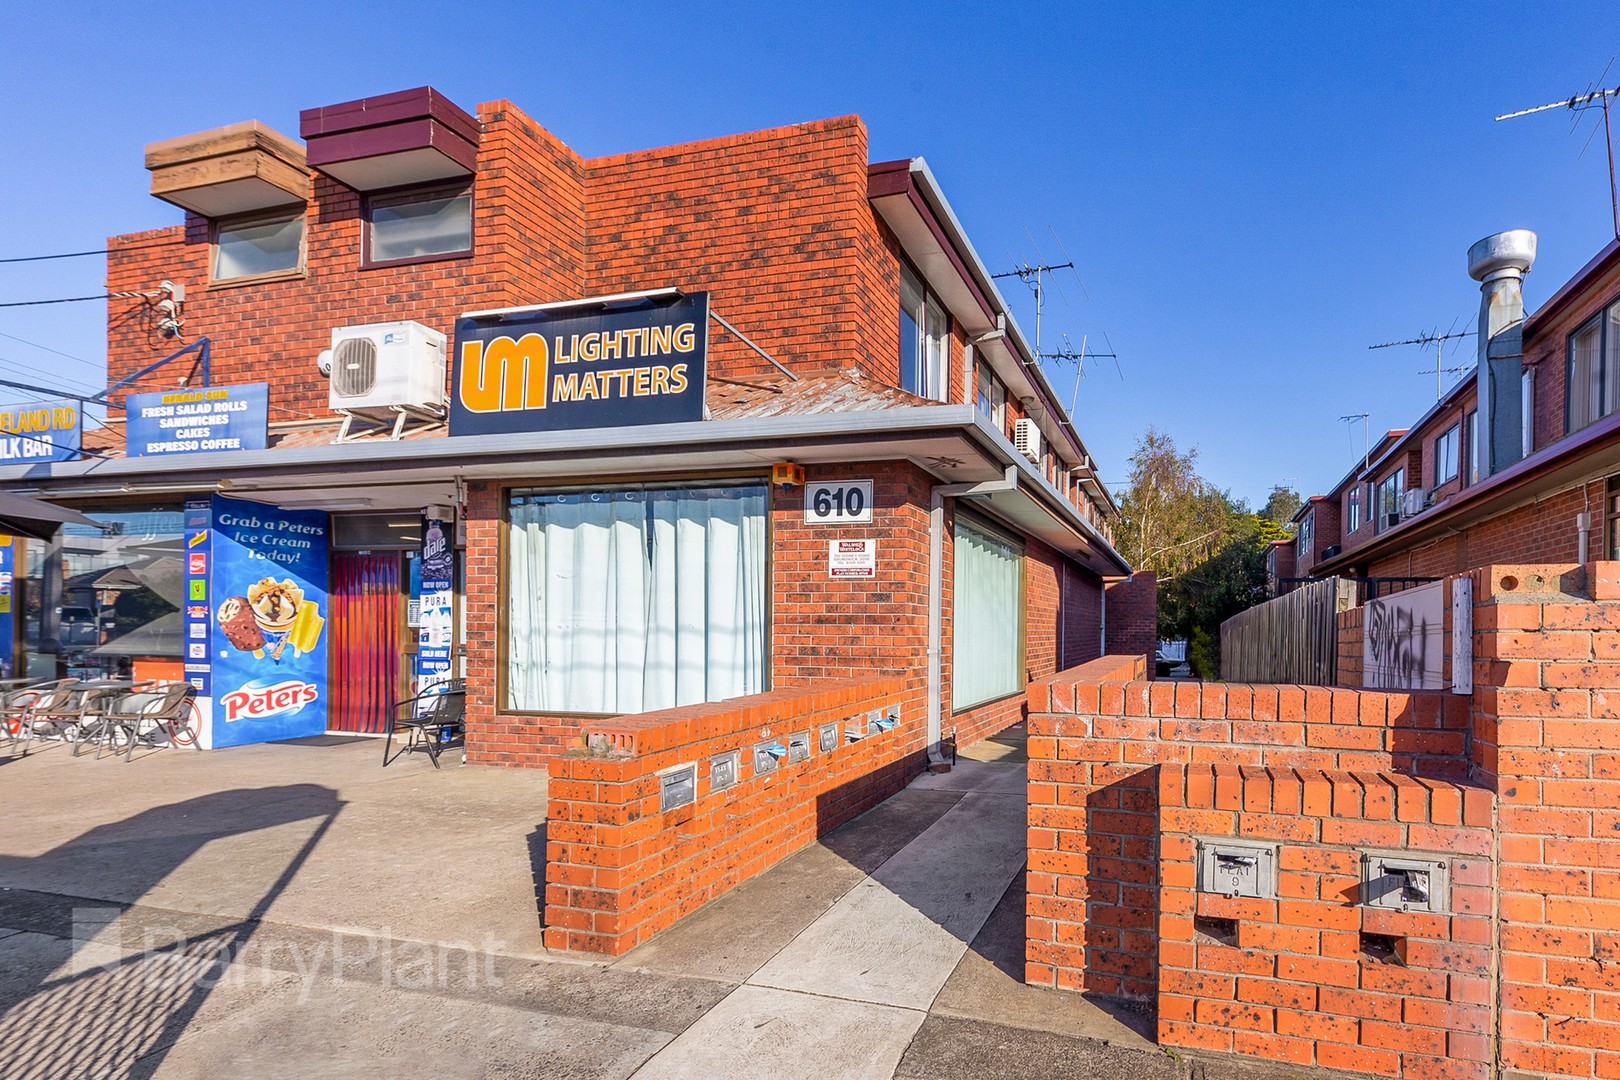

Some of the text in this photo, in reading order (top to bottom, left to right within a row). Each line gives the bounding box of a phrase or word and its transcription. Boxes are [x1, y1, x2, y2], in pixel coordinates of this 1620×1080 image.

[554, 323, 695, 364] LIGHTING
[552, 363, 688, 403] MATTERS
[205, 389, 228, 400] SUN
[141, 400, 248, 417] FRESH SALAD ROLLS
[52, 407, 75, 430] RD
[159, 414, 229, 428] SANDWICHES
[175, 427, 211, 439] CAKES
[23, 434, 53, 458] BAR
[147, 438, 240, 453] ESPRESSO COFFEE
[813, 487, 865, 517] 610
[218, 513, 261, 529] Grab
[264, 521, 275, 531] a
[278, 520, 324, 536] Peters
[234, 531, 311, 548] Ice Cream
[247, 547, 301, 565] Today!
[423, 537, 446, 560] dare
[425, 596, 447, 606] PURA
[424, 676, 447, 686] PURA
[222, 683, 317, 720] Peters
[1231, 876, 1240, 887] 9
